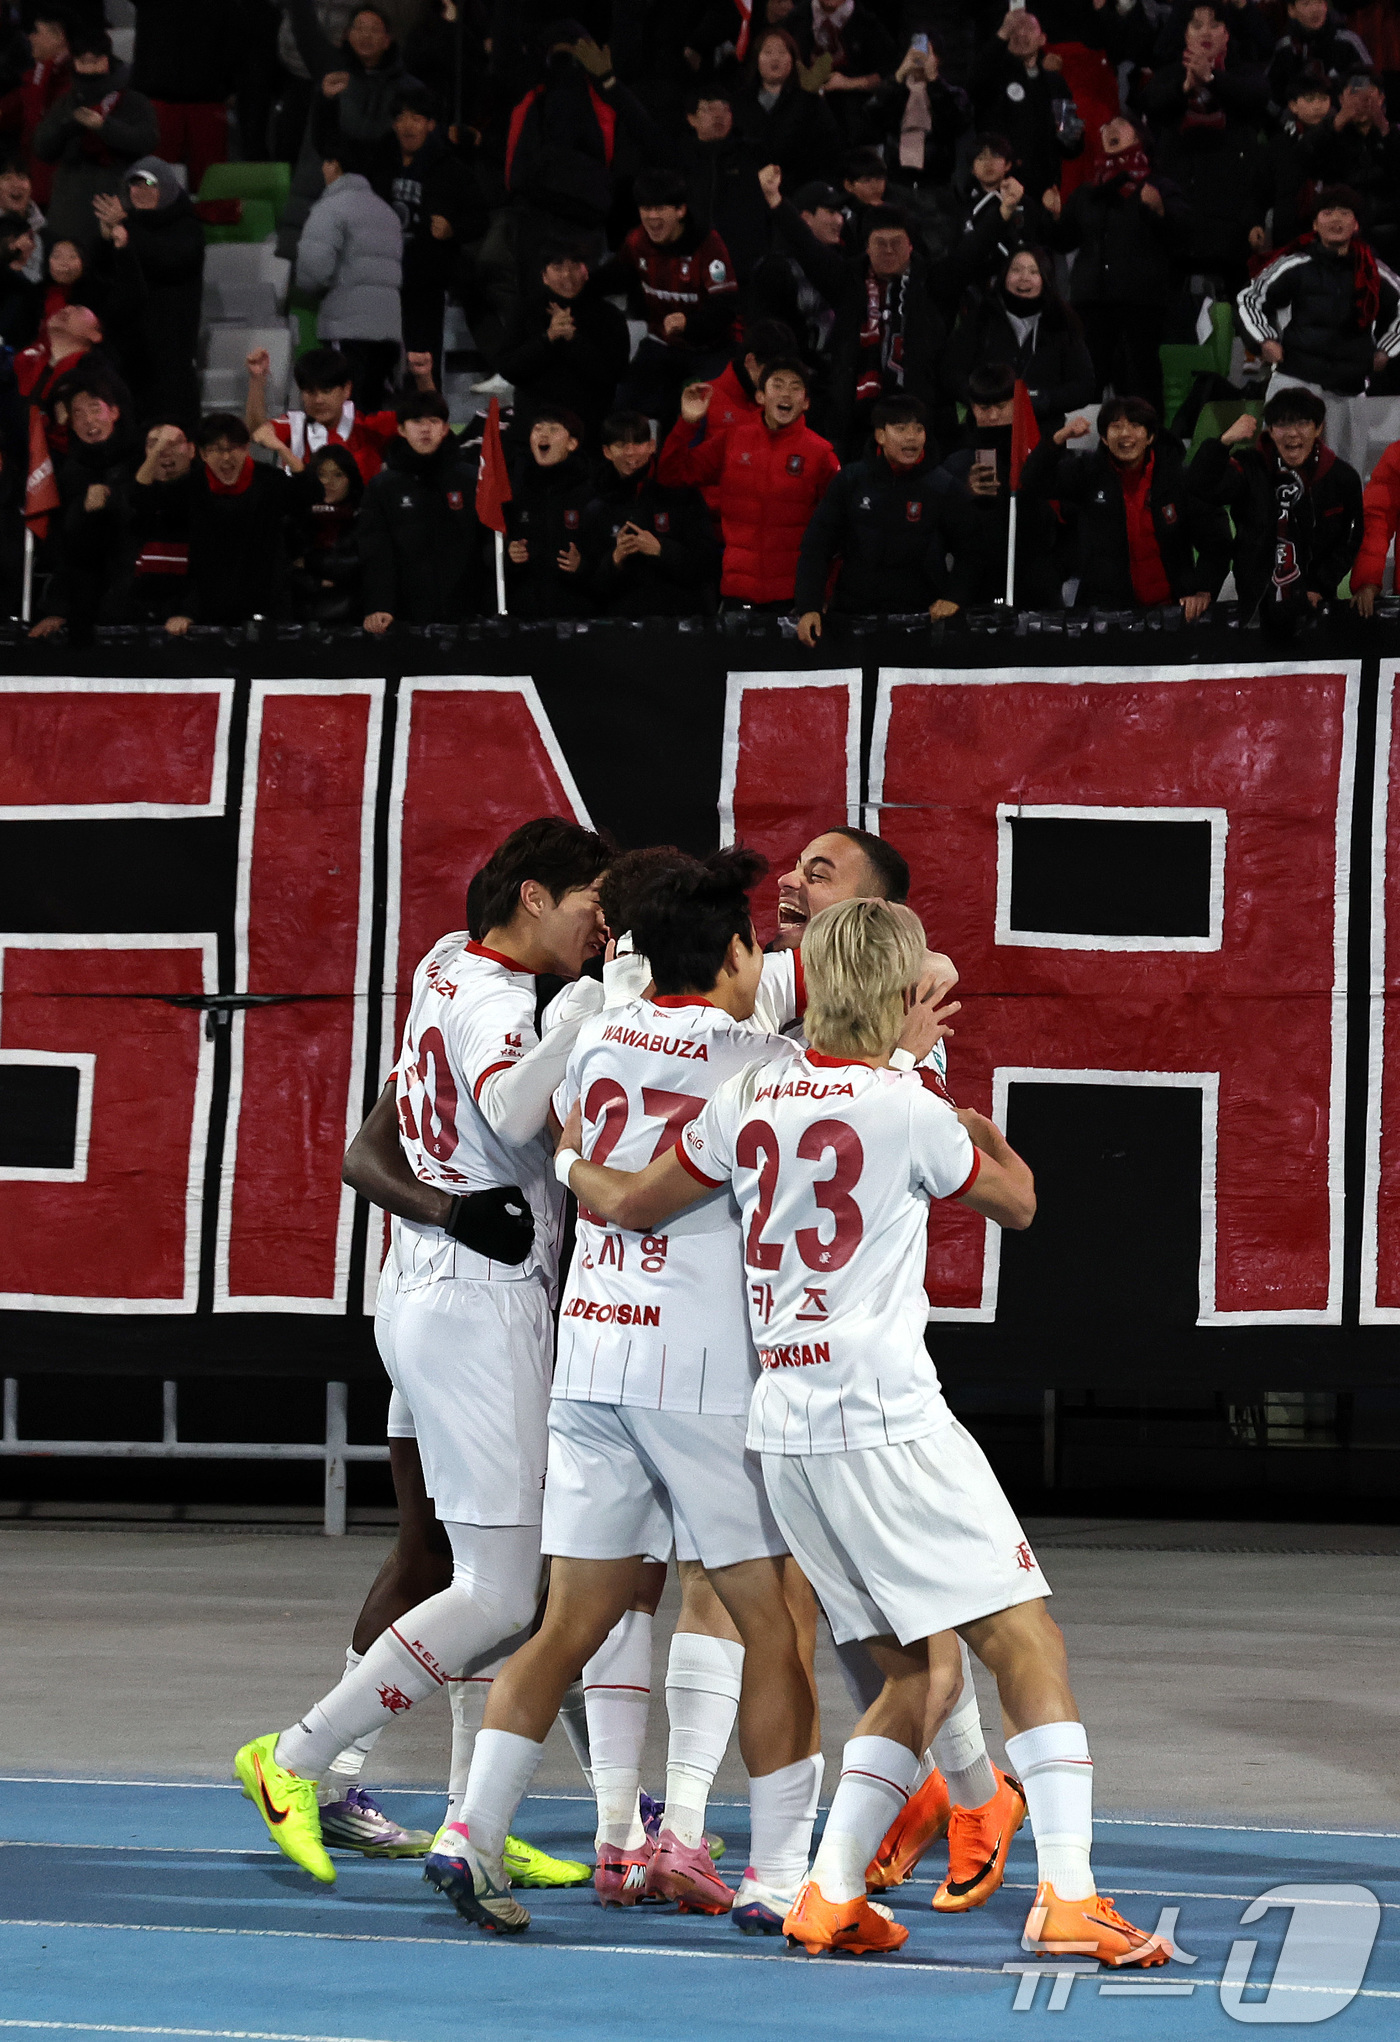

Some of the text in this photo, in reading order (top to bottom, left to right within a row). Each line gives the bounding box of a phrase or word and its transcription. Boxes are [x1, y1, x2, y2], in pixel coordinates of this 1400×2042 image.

[601, 1024, 709, 1062] WAWABUZA
[579, 1077, 708, 1228] 27
[736, 1118, 865, 1273] 23
[582, 1233, 669, 1273] 시영
[751, 1283, 829, 1325] 카즈
